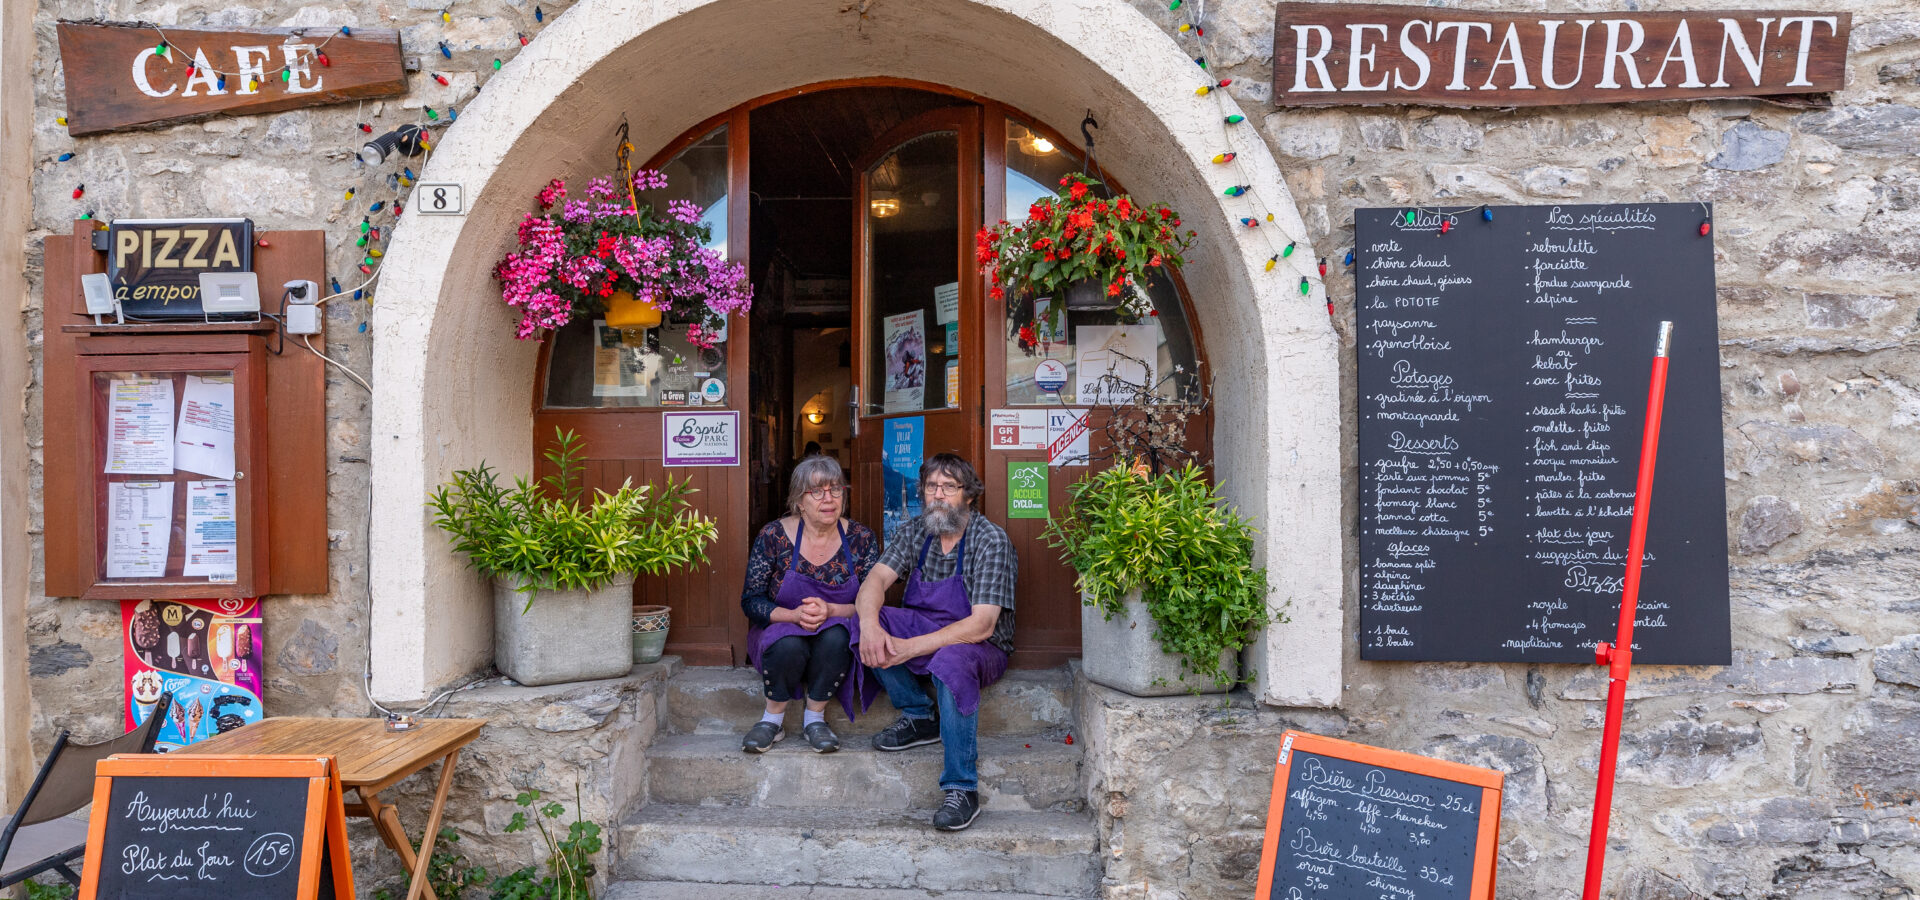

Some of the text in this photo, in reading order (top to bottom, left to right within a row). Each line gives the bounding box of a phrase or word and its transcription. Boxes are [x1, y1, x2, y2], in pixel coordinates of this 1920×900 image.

[1288, 16, 1838, 93] RESTAURANT
[433, 187, 447, 209] 8
[1391, 208, 1459, 228] Slads
[1546, 206, 1656, 233] Nos spécialités
[116, 228, 241, 268] PIZZA
[1371, 240, 1402, 252] verte
[1531, 237, 1598, 254] reboulette
[1410, 254, 1451, 269] chaud
[1533, 257, 1589, 276] farciette
[115, 276, 201, 306] à empor
[1533, 274, 1633, 295] fondue savoyarde
[1371, 296, 1388, 309] la
[1534, 293, 1578, 308] alpine
[1372, 319, 1437, 336] paysanne
[1372, 335, 1452, 358] grenobloise
[1531, 330, 1604, 354] hamburger
[1532, 355, 1578, 370] kebab
[1391, 360, 1452, 390] Potages
[1533, 372, 1602, 391] avec frites
[668, 391, 685, 401] Grave
[1375, 391, 1426, 409] gratinée
[1428, 392, 1439, 403] à
[1377, 409, 1459, 428] montagnarde
[1532, 402, 1626, 422] steack haché frites
[1051, 416, 1066, 426] IV
[678, 417, 728, 449] Esprit
[999, 427, 1013, 435] GR
[1531, 421, 1611, 439] omelette frites
[1000, 436, 1013, 444] 54
[1388, 431, 1459, 450] Desserts
[1533, 437, 1611, 457] fish and chips
[1375, 456, 1419, 474] gaufre
[1533, 456, 1620, 472] croque monsieur
[1375, 471, 1404, 482] tarte
[1406, 474, 1427, 482] aux
[1430, 474, 1470, 487] pommes
[1535, 472, 1605, 487] moules frites
[1014, 489, 1043, 498] ACCUEIL
[1375, 483, 1421, 499] fondant
[1426, 485, 1468, 495] chocolat
[1535, 488, 1636, 502] pâtes à la carbona
[1013, 500, 1033, 508] CYCLO
[1375, 497, 1421, 514] fromage
[1425, 498, 1457, 509] blanc
[1535, 505, 1572, 517] bavette
[1574, 507, 1584, 517] à
[1375, 514, 1415, 524] panna
[1419, 513, 1449, 523] cotta
[1535, 527, 1614, 546] plat du jour
[1387, 541, 1430, 558] Glaces
[1535, 550, 1599, 565] suggestion
[1602, 546, 1624, 561] du
[1372, 558, 1436, 573] banana split
[1373, 570, 1411, 582] alpina
[1373, 581, 1425, 594] dauphina
[1371, 600, 1423, 612] chartreuse
[1533, 598, 1568, 615] royale
[1374, 625, 1410, 636] 1 boule
[1532, 619, 1539, 629] 4
[1541, 617, 1586, 634] fromages
[1375, 636, 1414, 647] 2 boules
[1506, 637, 1563, 654] napolitaine
[1301, 758, 1355, 790] Bière
[1362, 769, 1436, 808] Pression
[1441, 795, 1461, 812] 25
[125, 790, 257, 833] Aujourd'hui
[1290, 789, 1448, 831] affligem leffe heineken
[121, 840, 291, 879] Plat du Jour 15€
[1290, 827, 1343, 859] Bière
[1346, 845, 1407, 873] bouteille
[1419, 866, 1439, 883] 33
[1296, 860, 1416, 899] orval chimay
